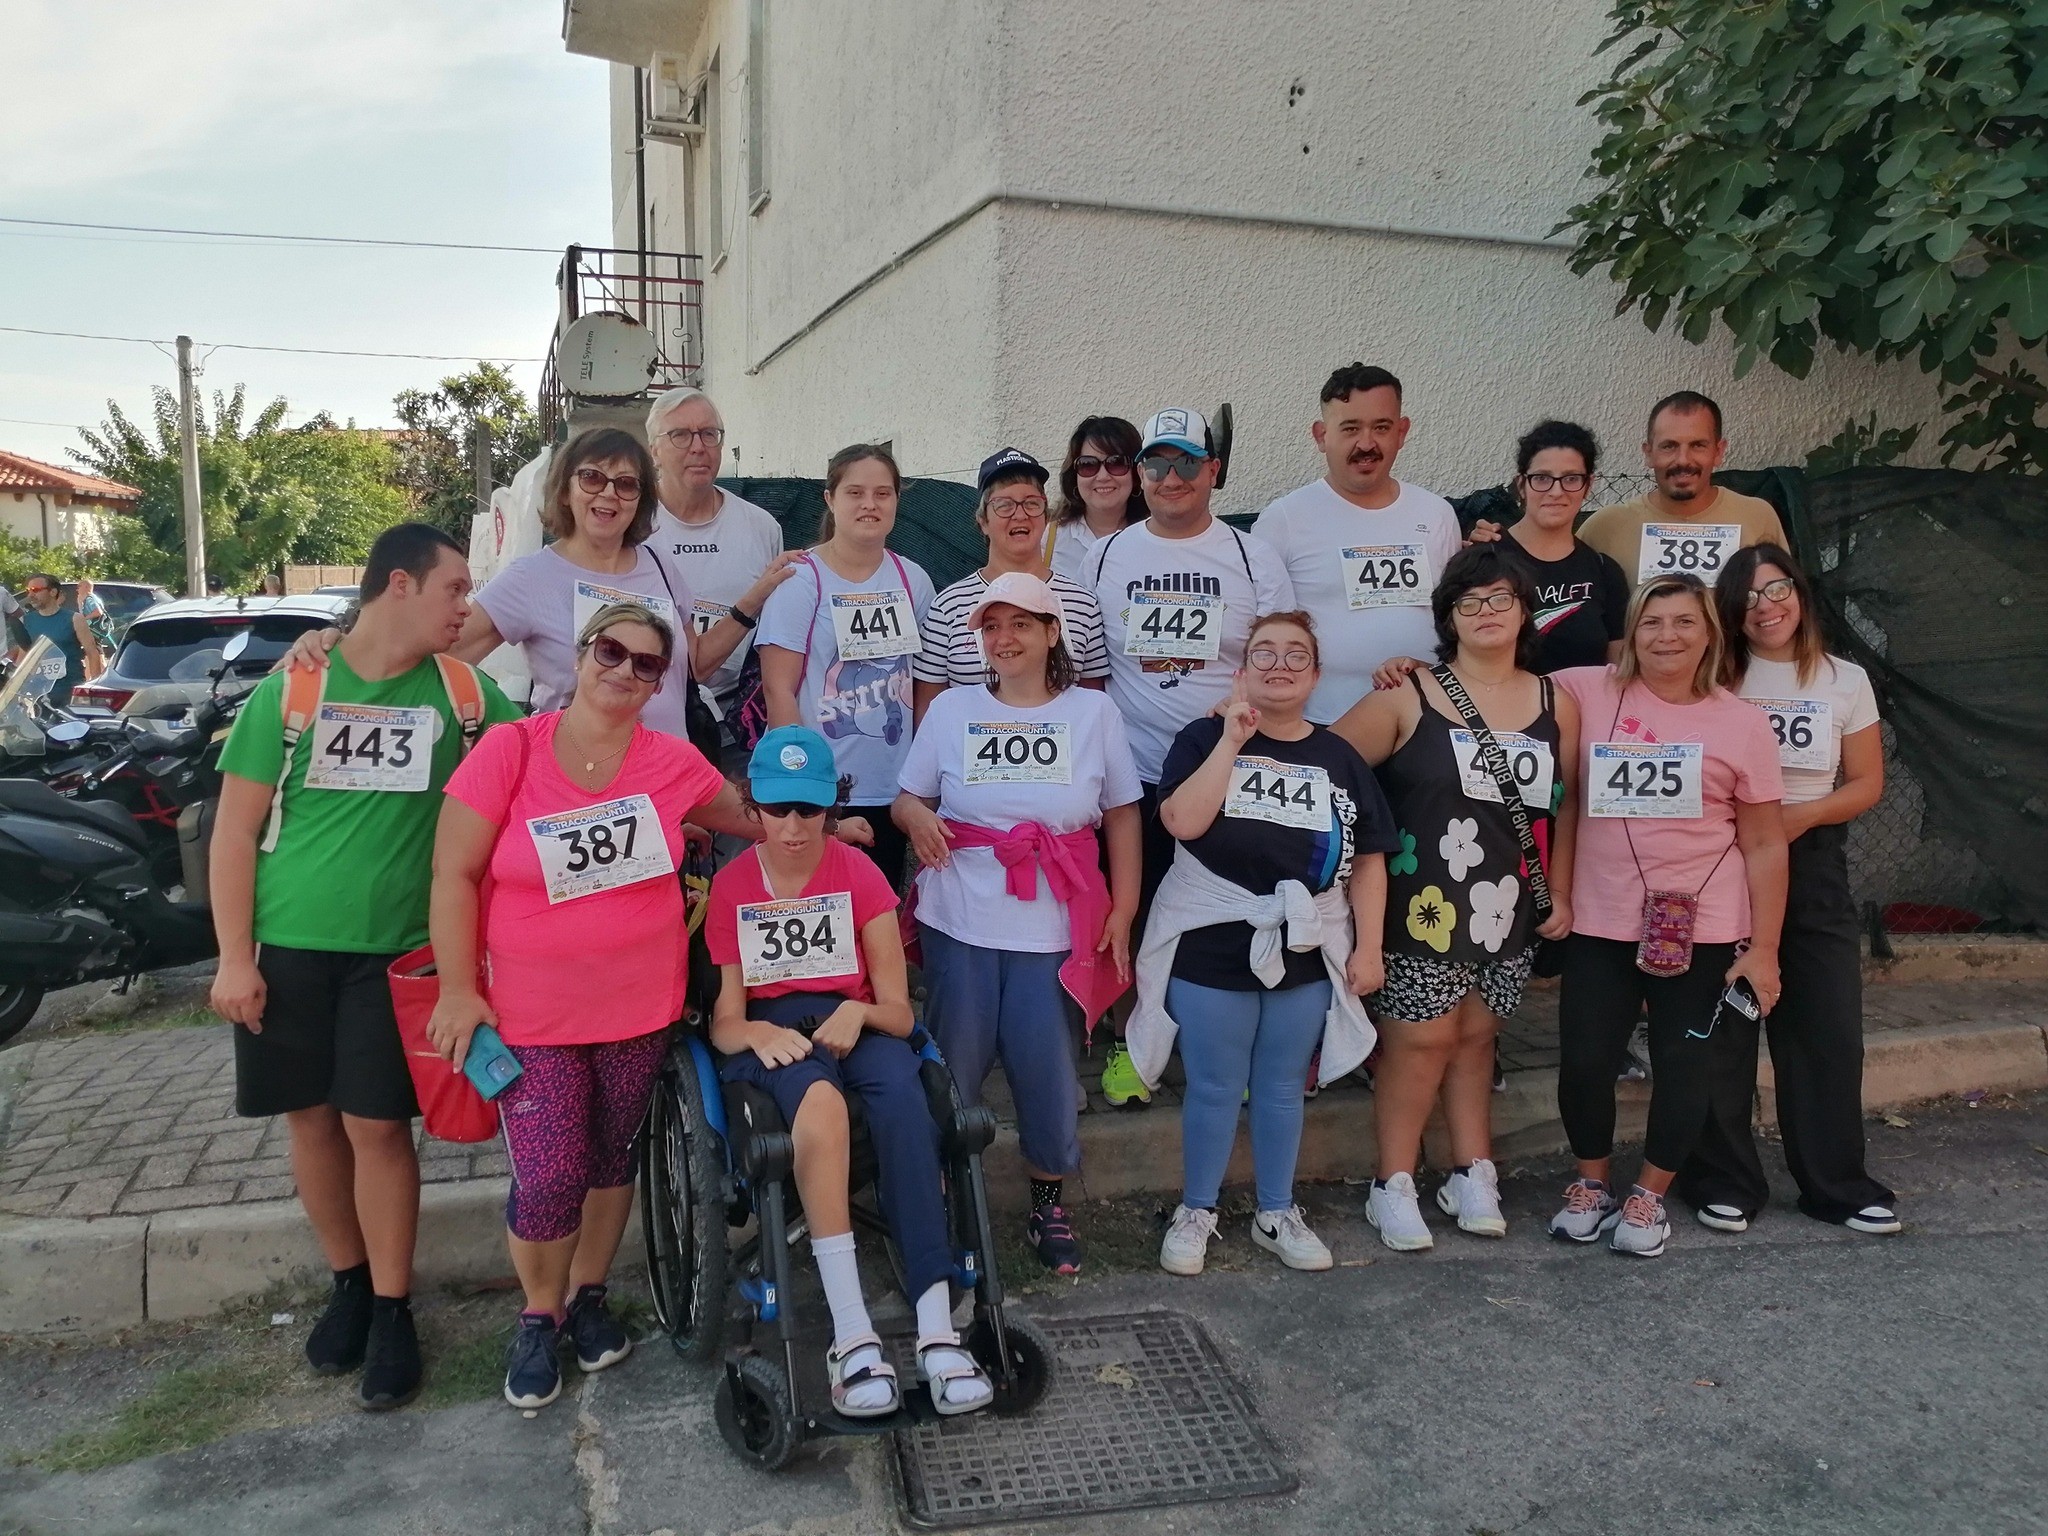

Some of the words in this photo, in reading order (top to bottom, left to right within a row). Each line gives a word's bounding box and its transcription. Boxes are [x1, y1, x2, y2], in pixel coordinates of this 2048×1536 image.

[582, 330, 594, 359] System
[580, 361, 589, 380] TELE
[1657, 540, 1721, 570] 383
[1127, 572, 1220, 600] chillin
[1358, 558, 1419, 589] 426
[1145, 598, 1202, 606] STRACONGIUNTI
[850, 606, 901, 640] 441
[1141, 607, 1207, 641] 442
[1436, 671, 1480, 720] BIMBAY
[331, 712, 406, 725] STRACONGIUNTI
[1768, 714, 1813, 749] 86
[325, 725, 414, 768] 443
[977, 735, 1058, 765] 400
[1472, 728, 1513, 785] BIMBAY
[1606, 750, 1677, 758] STRACONGIUNTI
[1469, 748, 1539, 786] 40
[1607, 761, 1682, 797] 425
[1240, 771, 1316, 812] 444
[549, 807, 627, 831] STRACONGIUNTI
[1330, 783, 1357, 888] PESCAR
[1504, 795, 1535, 850] BIMBAY
[558, 815, 637, 872] 387
[1528, 859, 1552, 910] BIMBAY
[754, 903, 826, 919] STRACONGIUNTI
[757, 914, 836, 961] 384
